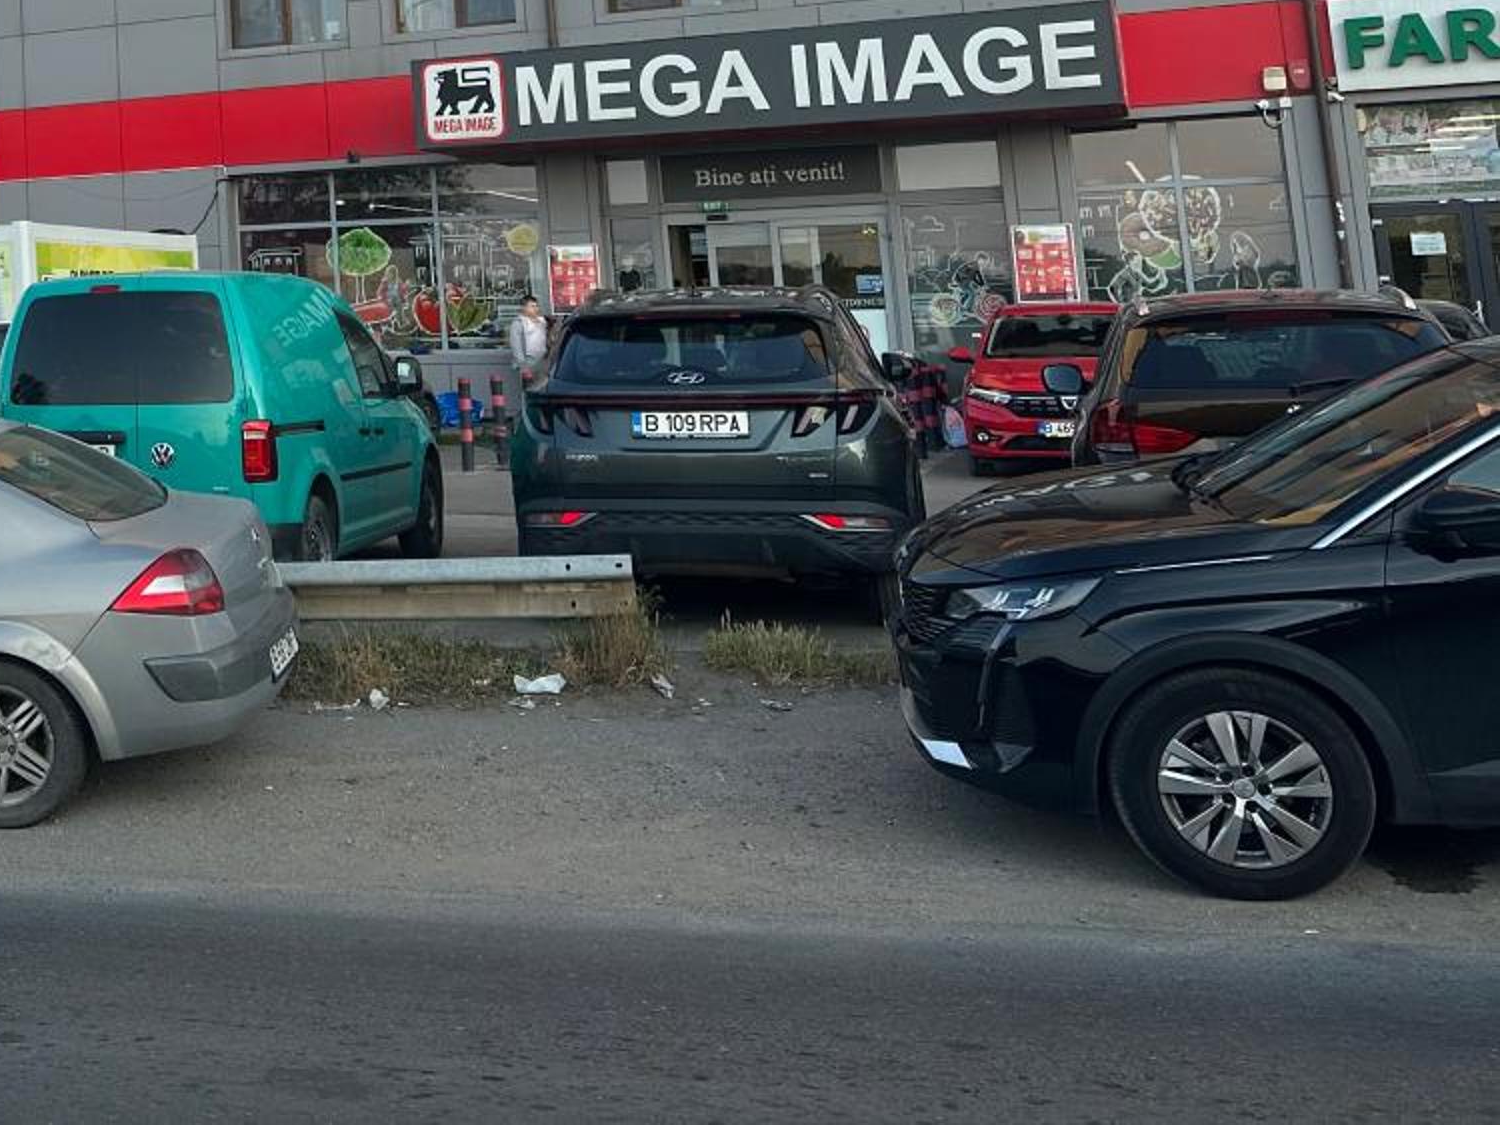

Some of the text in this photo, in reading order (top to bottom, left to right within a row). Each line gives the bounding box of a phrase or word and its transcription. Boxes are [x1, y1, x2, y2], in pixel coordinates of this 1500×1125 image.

[1343, 8, 1500, 70] FAR
[515, 19, 1101, 127] MEGA IMAGE
[434, 118, 463, 133] MEGA
[694, 161, 845, 187] Bine ați venit!
[645, 413, 741, 432] B 109 RPA
